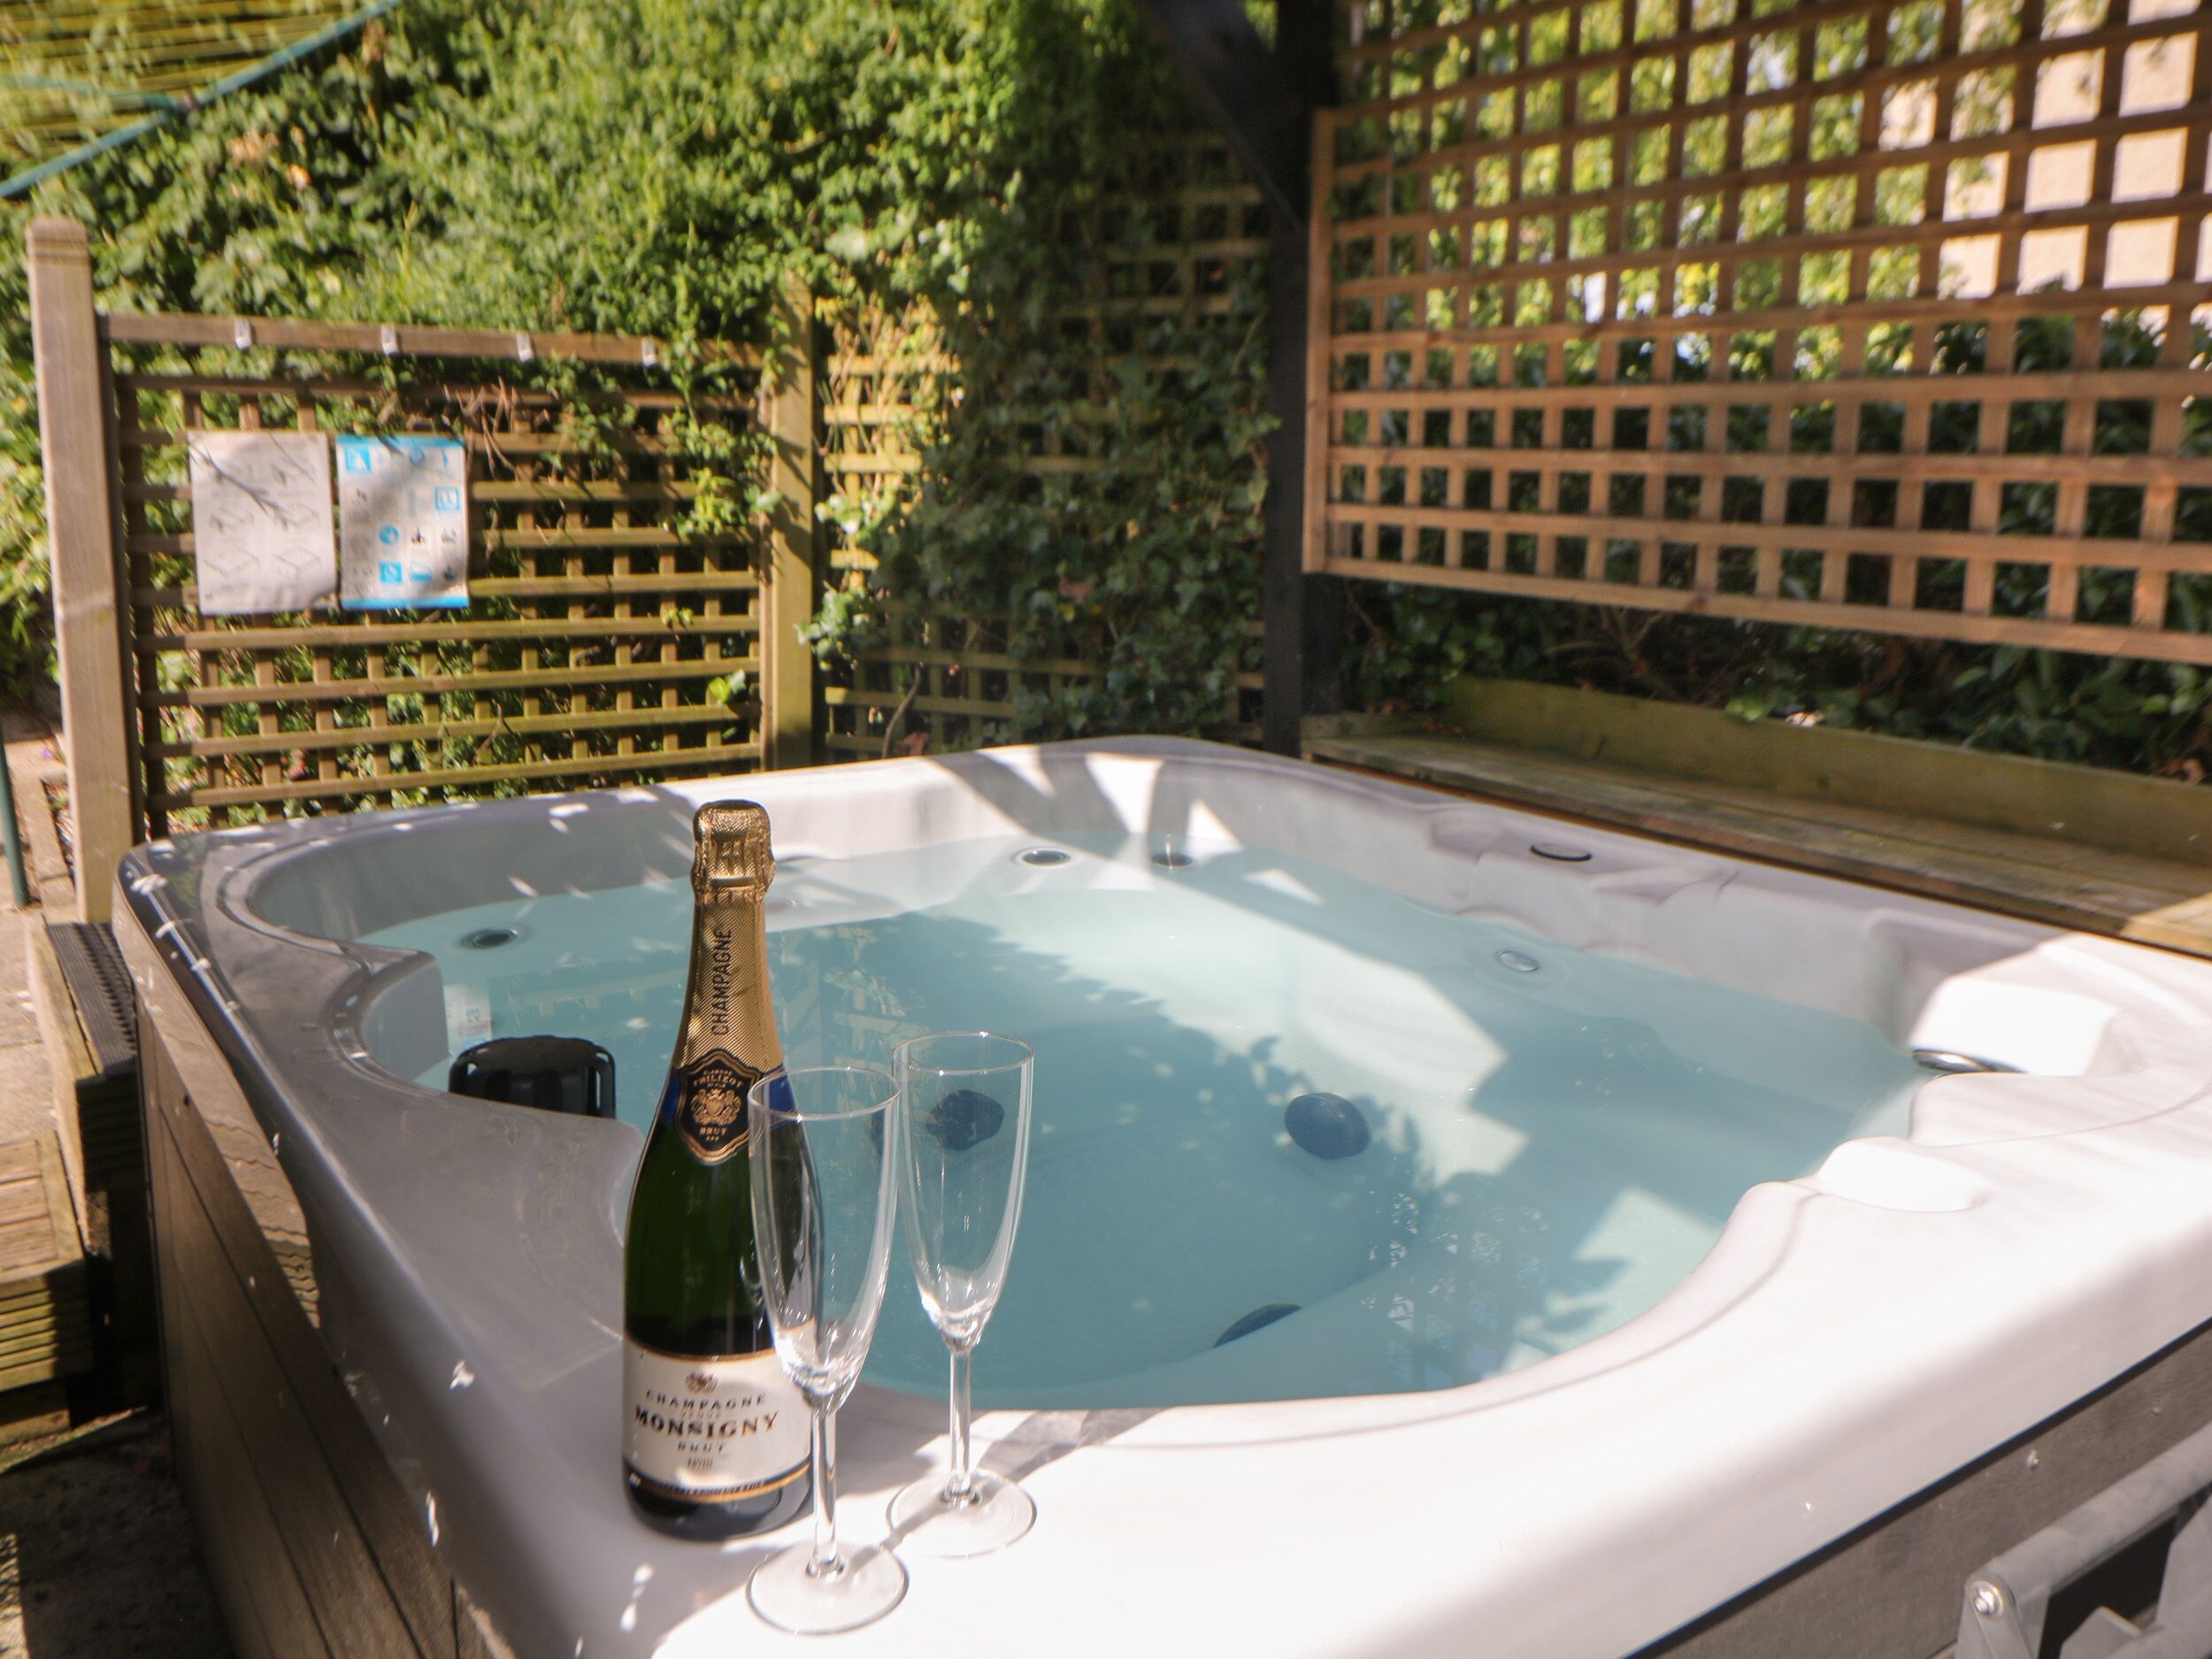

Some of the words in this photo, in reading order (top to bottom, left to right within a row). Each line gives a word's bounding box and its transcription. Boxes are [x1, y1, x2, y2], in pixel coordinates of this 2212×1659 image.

[710, 929, 732, 1036] CHAMPAGNE
[647, 1389, 766, 1409] CHAMPAGNE
[634, 1405, 779, 1439] MONSIGNY
